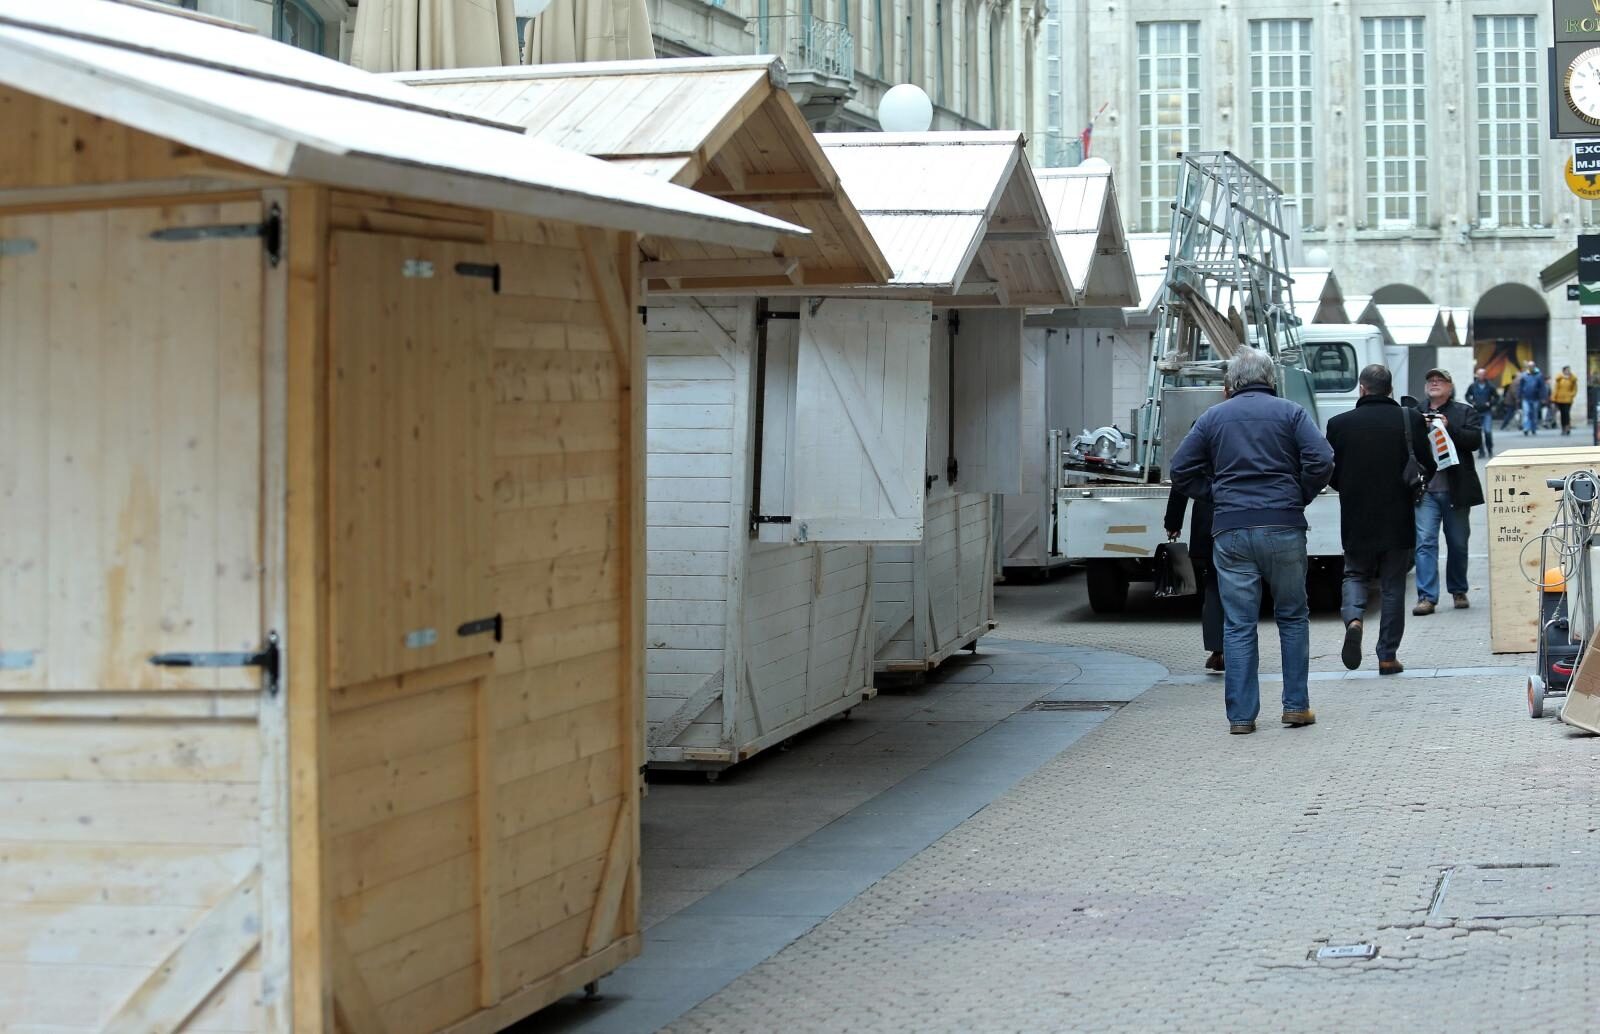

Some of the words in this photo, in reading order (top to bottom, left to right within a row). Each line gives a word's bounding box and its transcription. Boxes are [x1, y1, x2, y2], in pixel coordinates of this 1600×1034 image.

[1493, 505, 1531, 514] FRAGILE
[1500, 526, 1521, 534] Made
[1506, 534, 1524, 543] Italy
